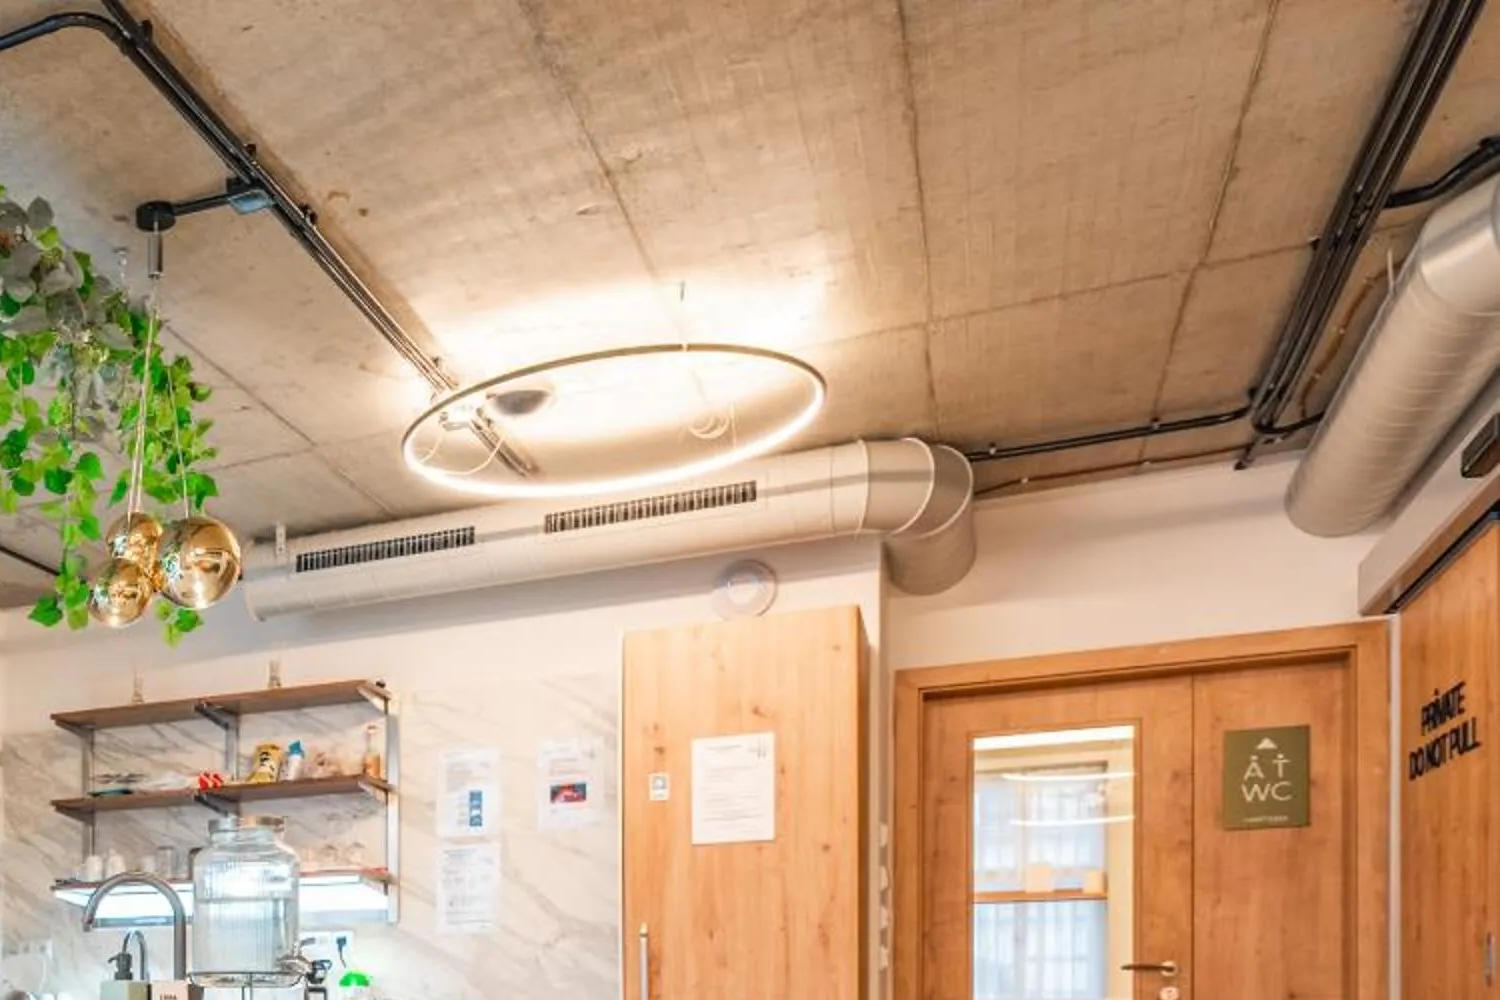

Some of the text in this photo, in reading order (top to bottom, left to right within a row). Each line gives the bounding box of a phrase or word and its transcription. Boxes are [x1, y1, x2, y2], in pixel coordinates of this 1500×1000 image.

[1409, 716, 1481, 780] DO NOT PULL
[1241, 780, 1293, 802] WC
